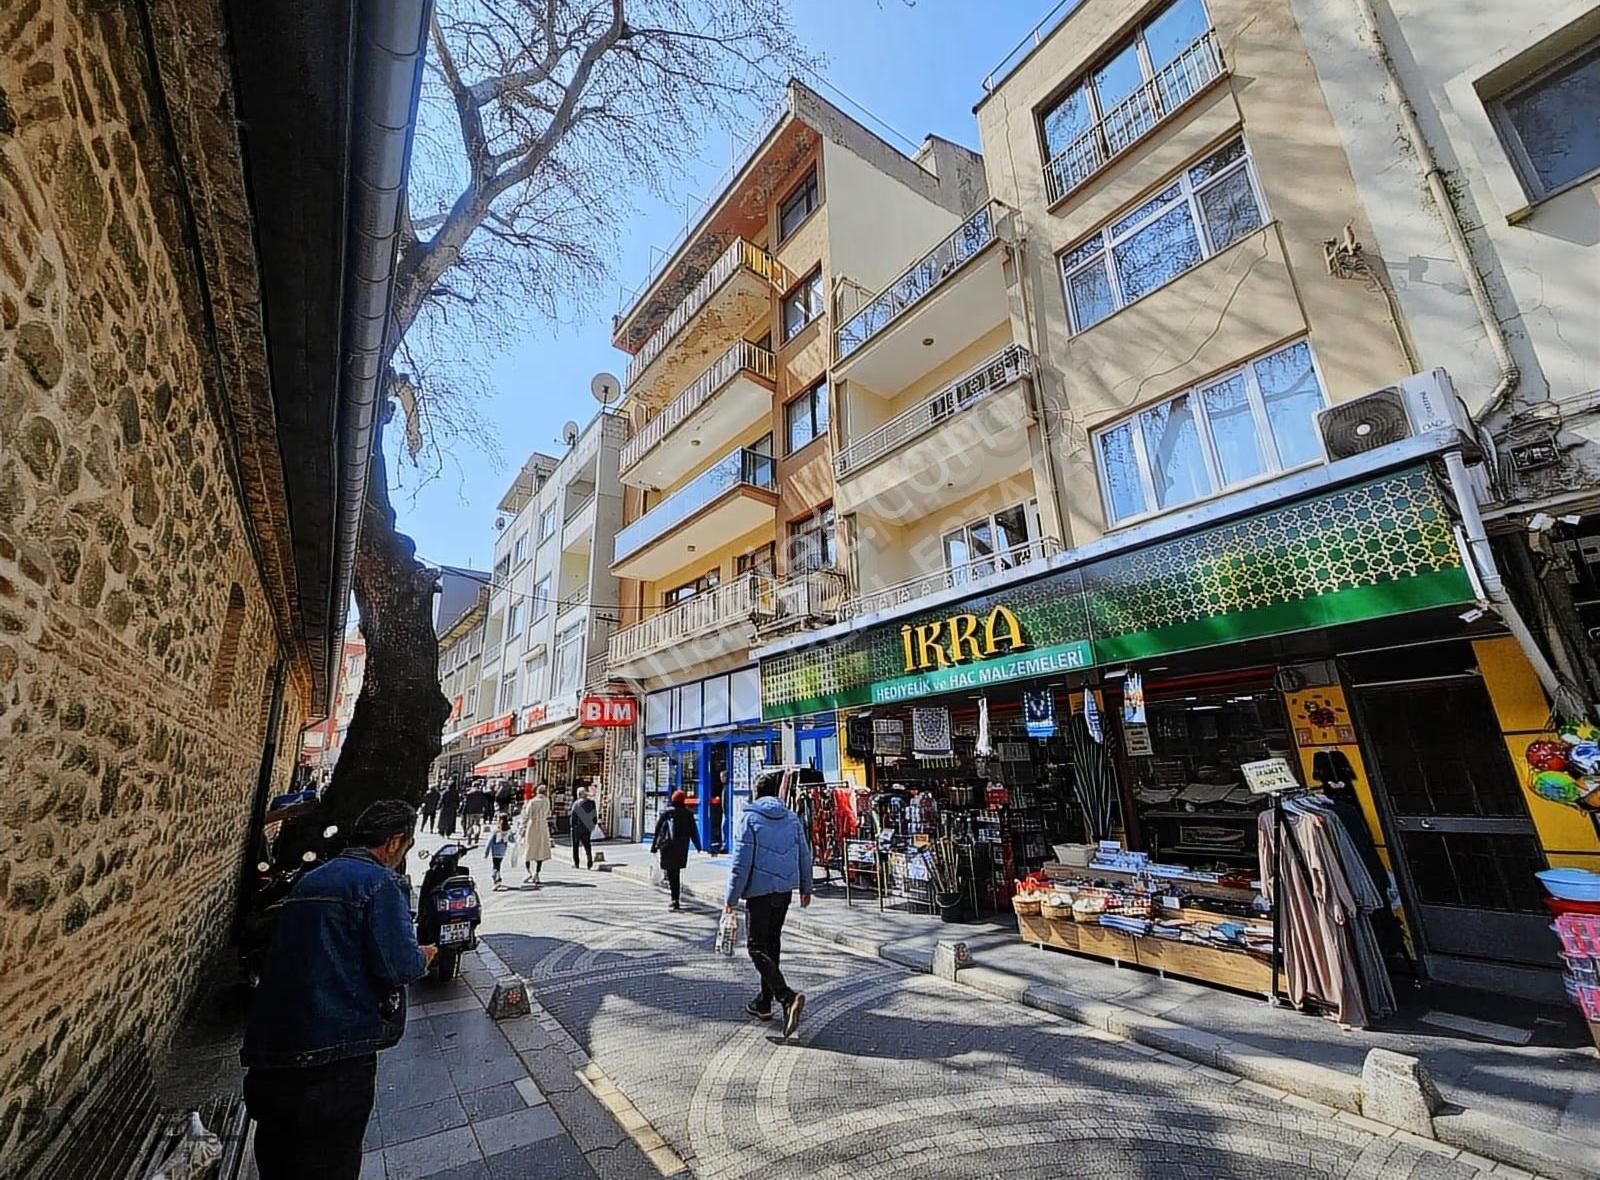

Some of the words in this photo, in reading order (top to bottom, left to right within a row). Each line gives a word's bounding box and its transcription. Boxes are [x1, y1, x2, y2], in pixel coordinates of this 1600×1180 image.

[901, 605, 1026, 672] İKRA
[948, 671, 976, 687] HAC
[980, 647, 1084, 682] MALZEMELERİ
